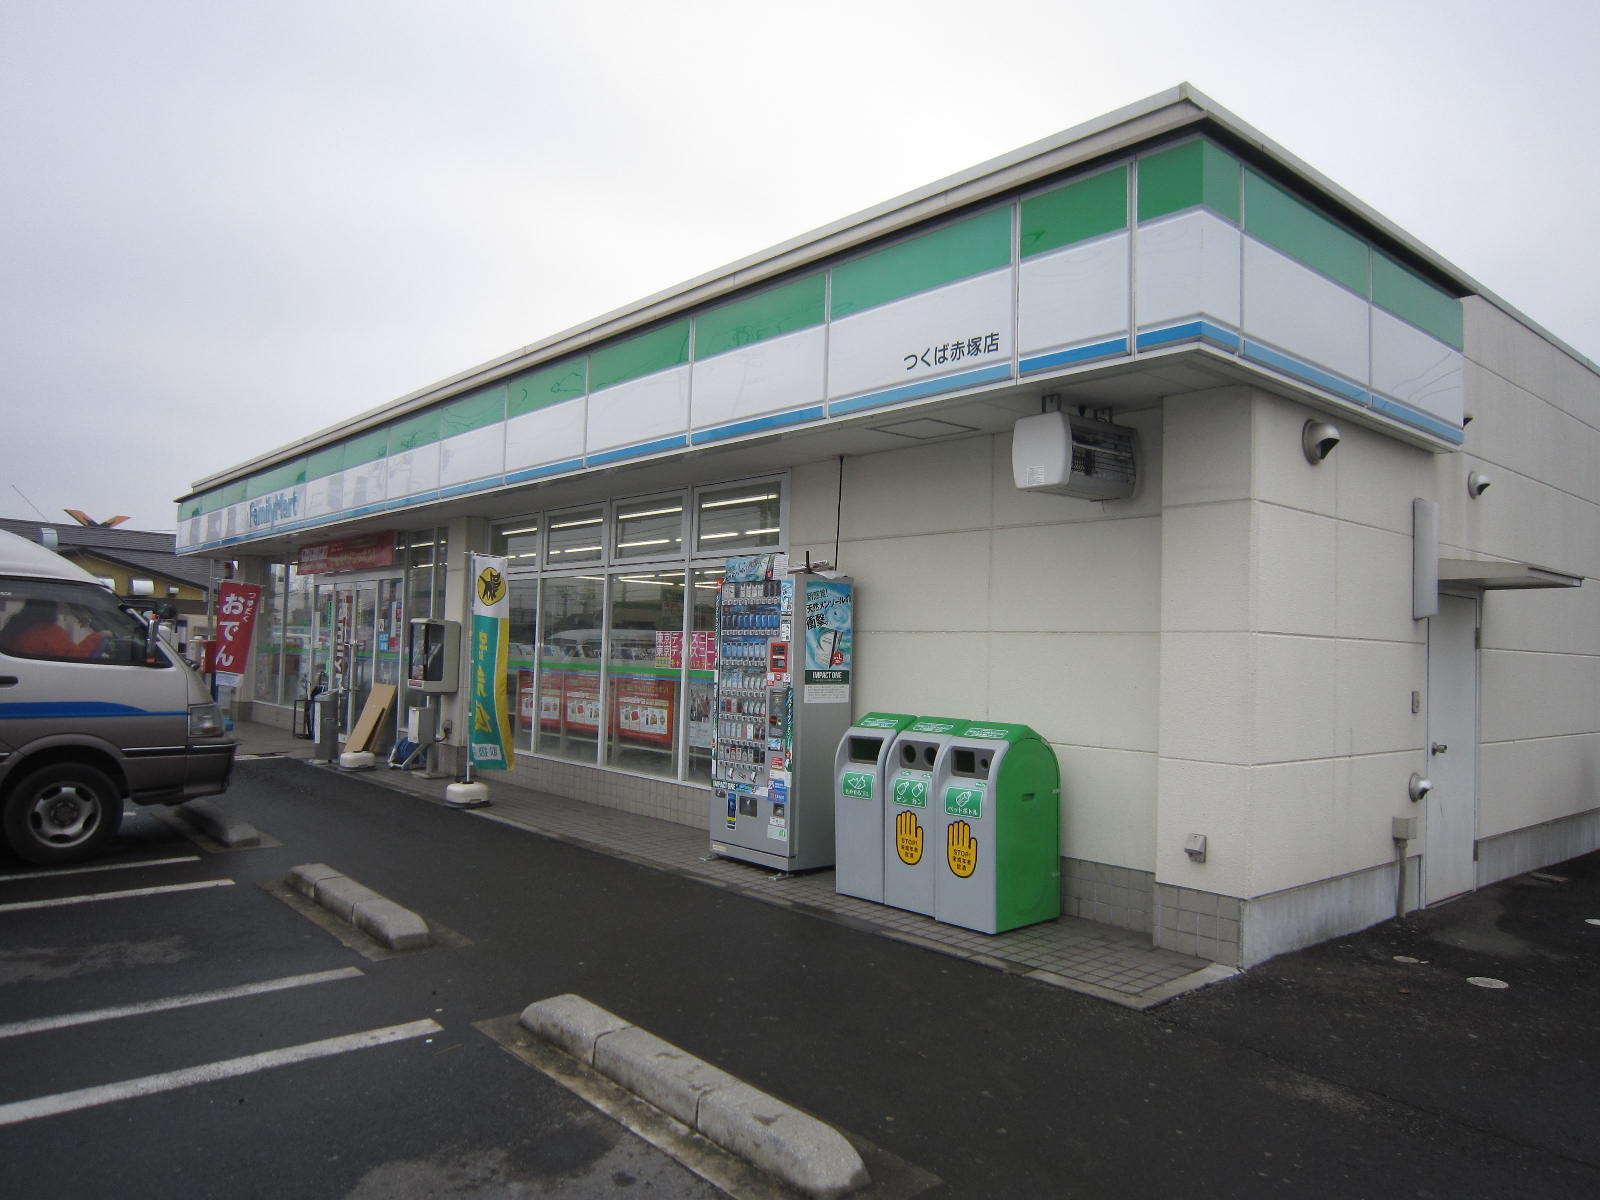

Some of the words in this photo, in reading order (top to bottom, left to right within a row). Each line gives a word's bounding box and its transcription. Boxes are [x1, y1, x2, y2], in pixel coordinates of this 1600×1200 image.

[903, 332, 1000, 371] つくば赤塚店
[216, 593, 246, 667] おでん
[812, 671, 832, 679] IMPACT
[831, 671, 843, 679] ONE
[947, 806, 979, 816] ペットボトル
[953, 849, 971, 857] STOP!
